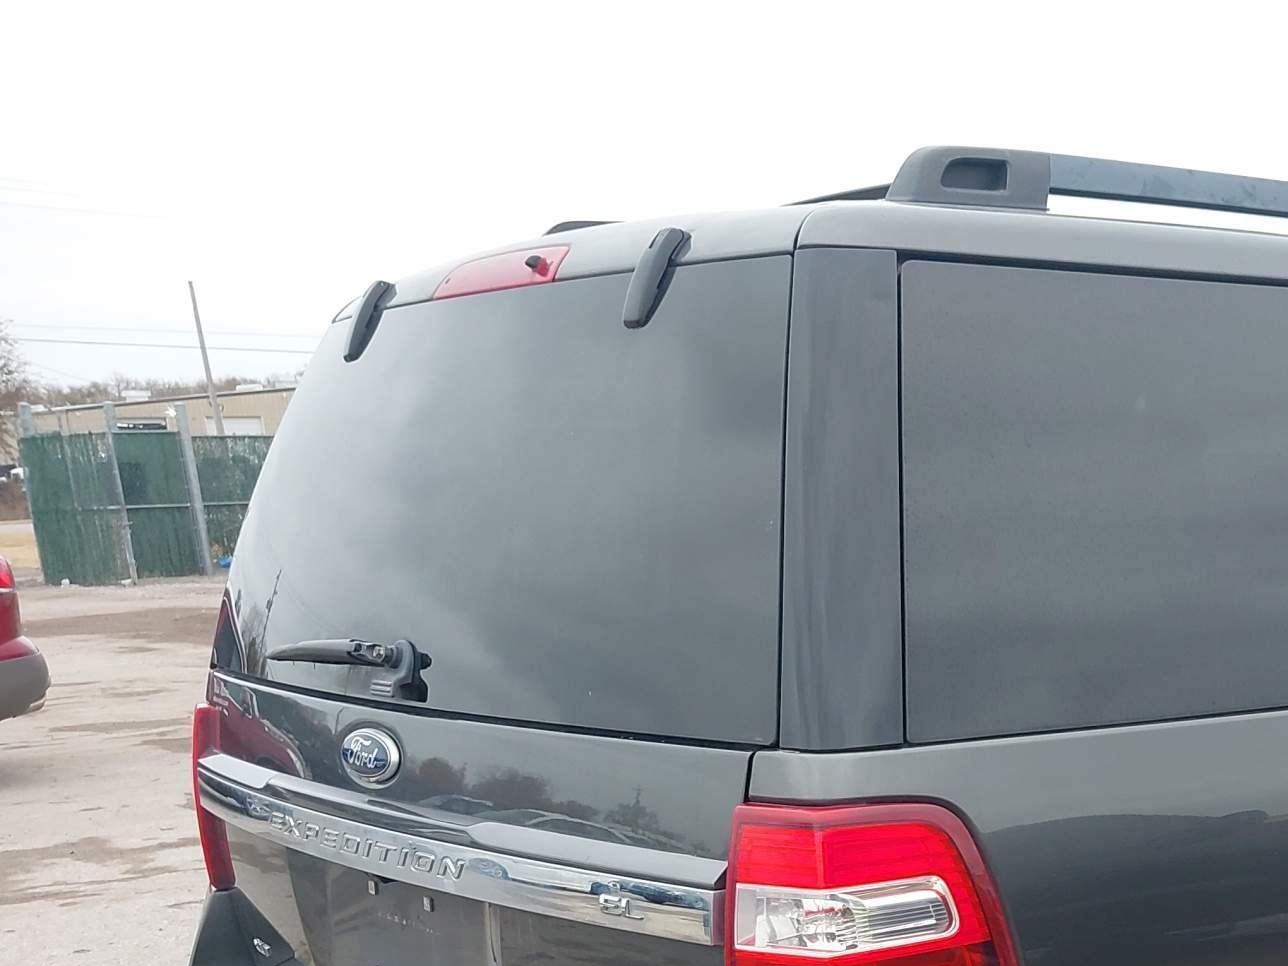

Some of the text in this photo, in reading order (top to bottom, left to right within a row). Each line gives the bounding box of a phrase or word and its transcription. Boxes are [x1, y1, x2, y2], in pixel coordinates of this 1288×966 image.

[347, 735, 384, 769] Ford
[270, 810, 467, 881] EXPEDITION
[599, 893, 645, 920] EL
